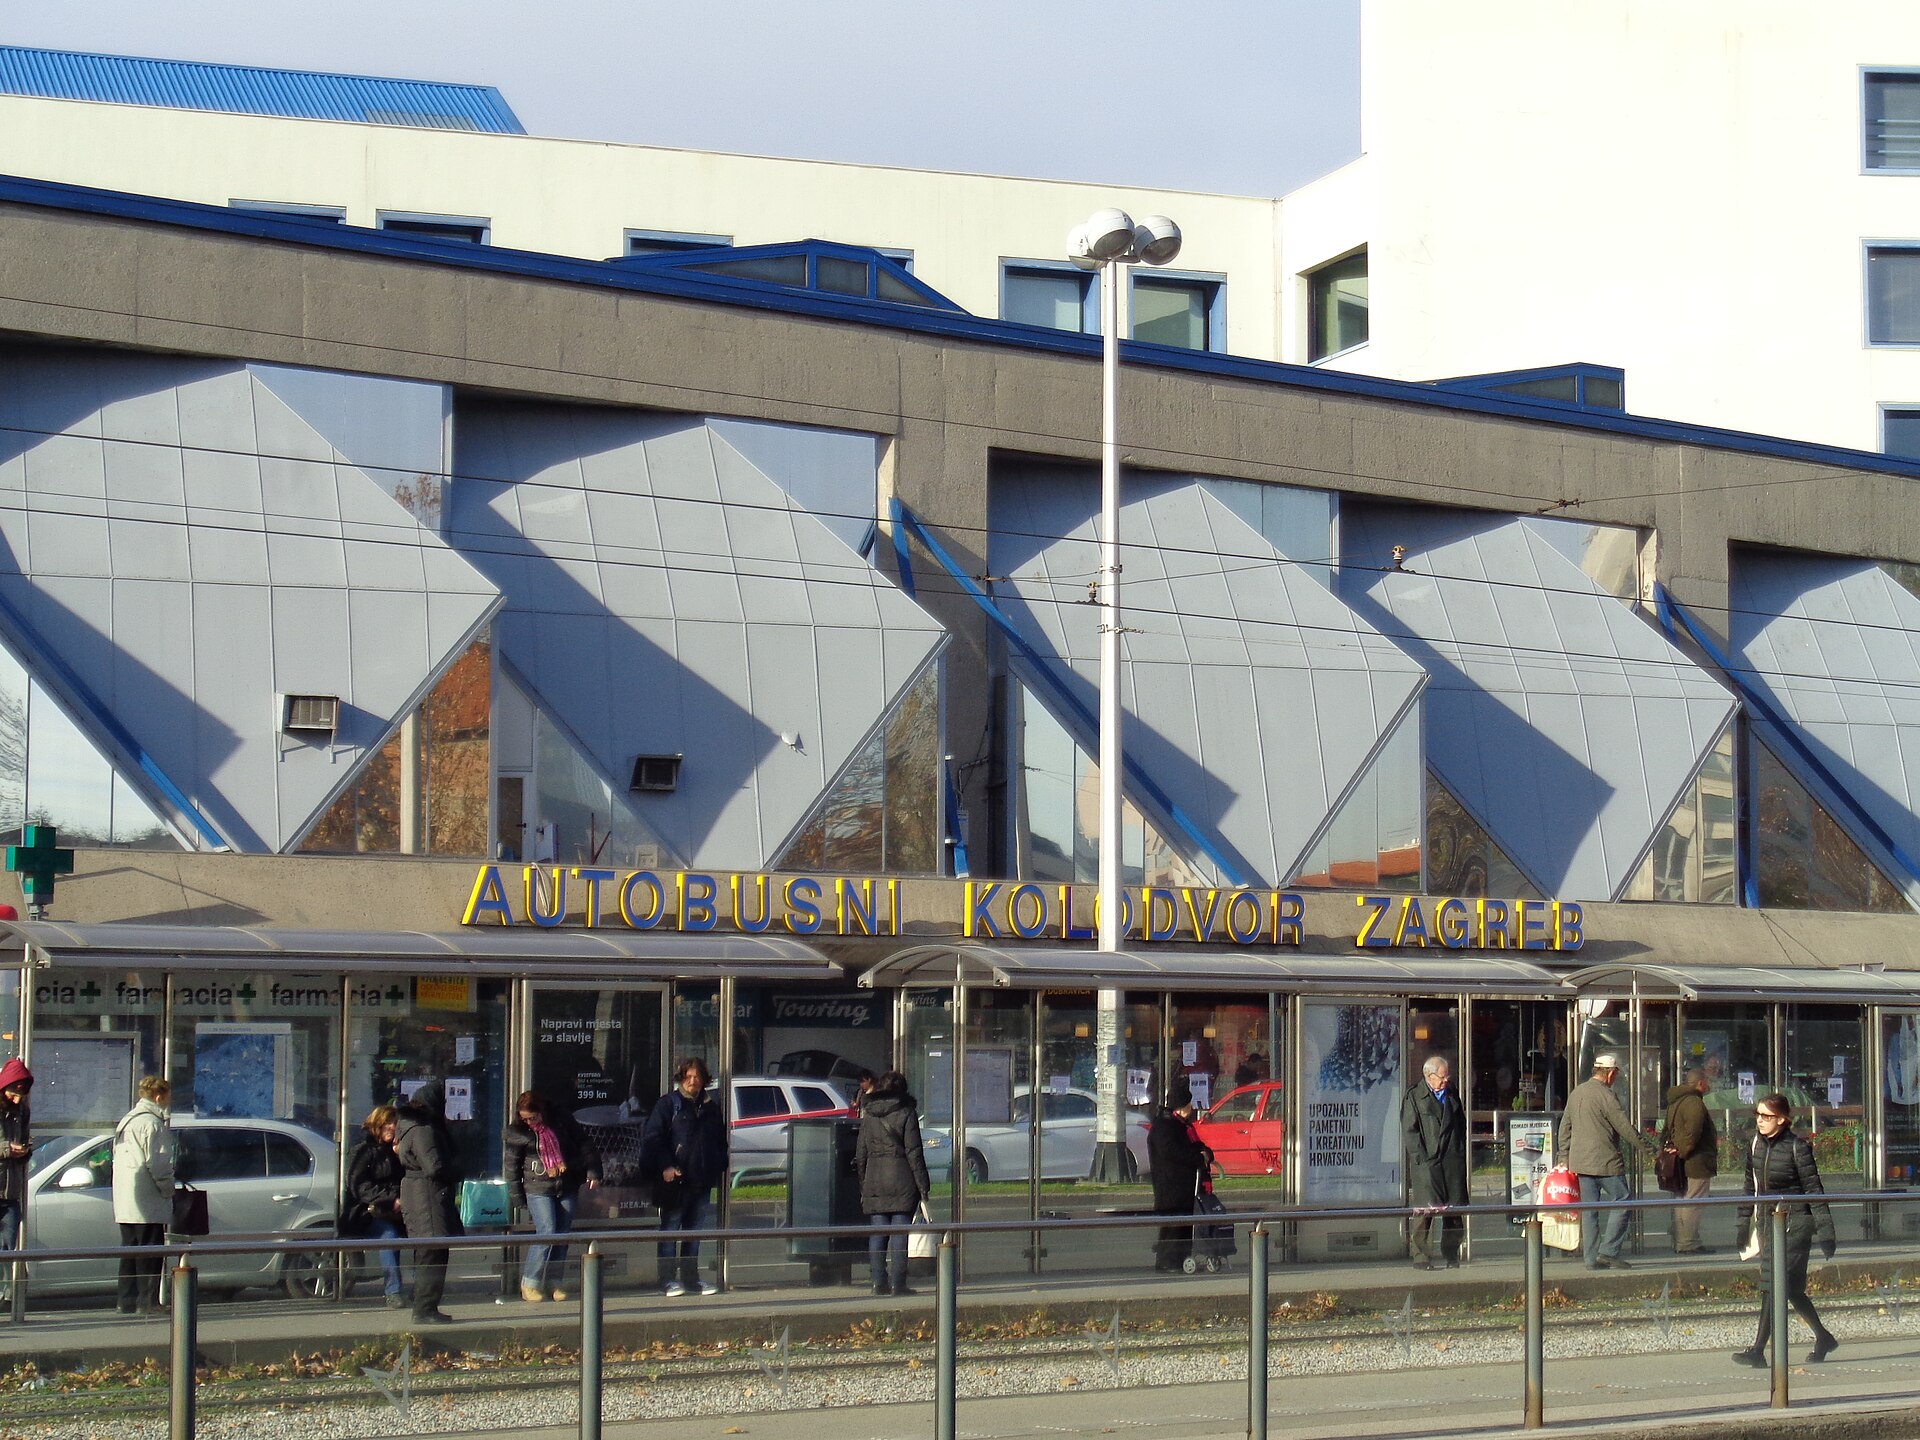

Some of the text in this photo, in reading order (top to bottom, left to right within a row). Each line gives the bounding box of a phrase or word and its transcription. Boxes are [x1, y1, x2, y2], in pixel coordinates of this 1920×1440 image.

[461, 865, 902, 937] AUTOBUSNI
[1356, 895, 1586, 952] ZAGREB
[270, 983, 382, 1008] farmacia
[772, 992, 875, 1026] Touring
[540, 1018, 622, 1031] Napravi mjesta
[540, 1032, 592, 1045] za slavlje
[577, 1090, 607, 1099] 399 kn
[1309, 1103, 1359, 1118] UPOZNAJTE
[1309, 1119, 1351, 1134] PAMETNU
[1309, 1135, 1365, 1150] I KREATIVNU
[1309, 1151, 1355, 1167] HRVATSKU
[620, 1200, 650, 1209] IKEA.hr
